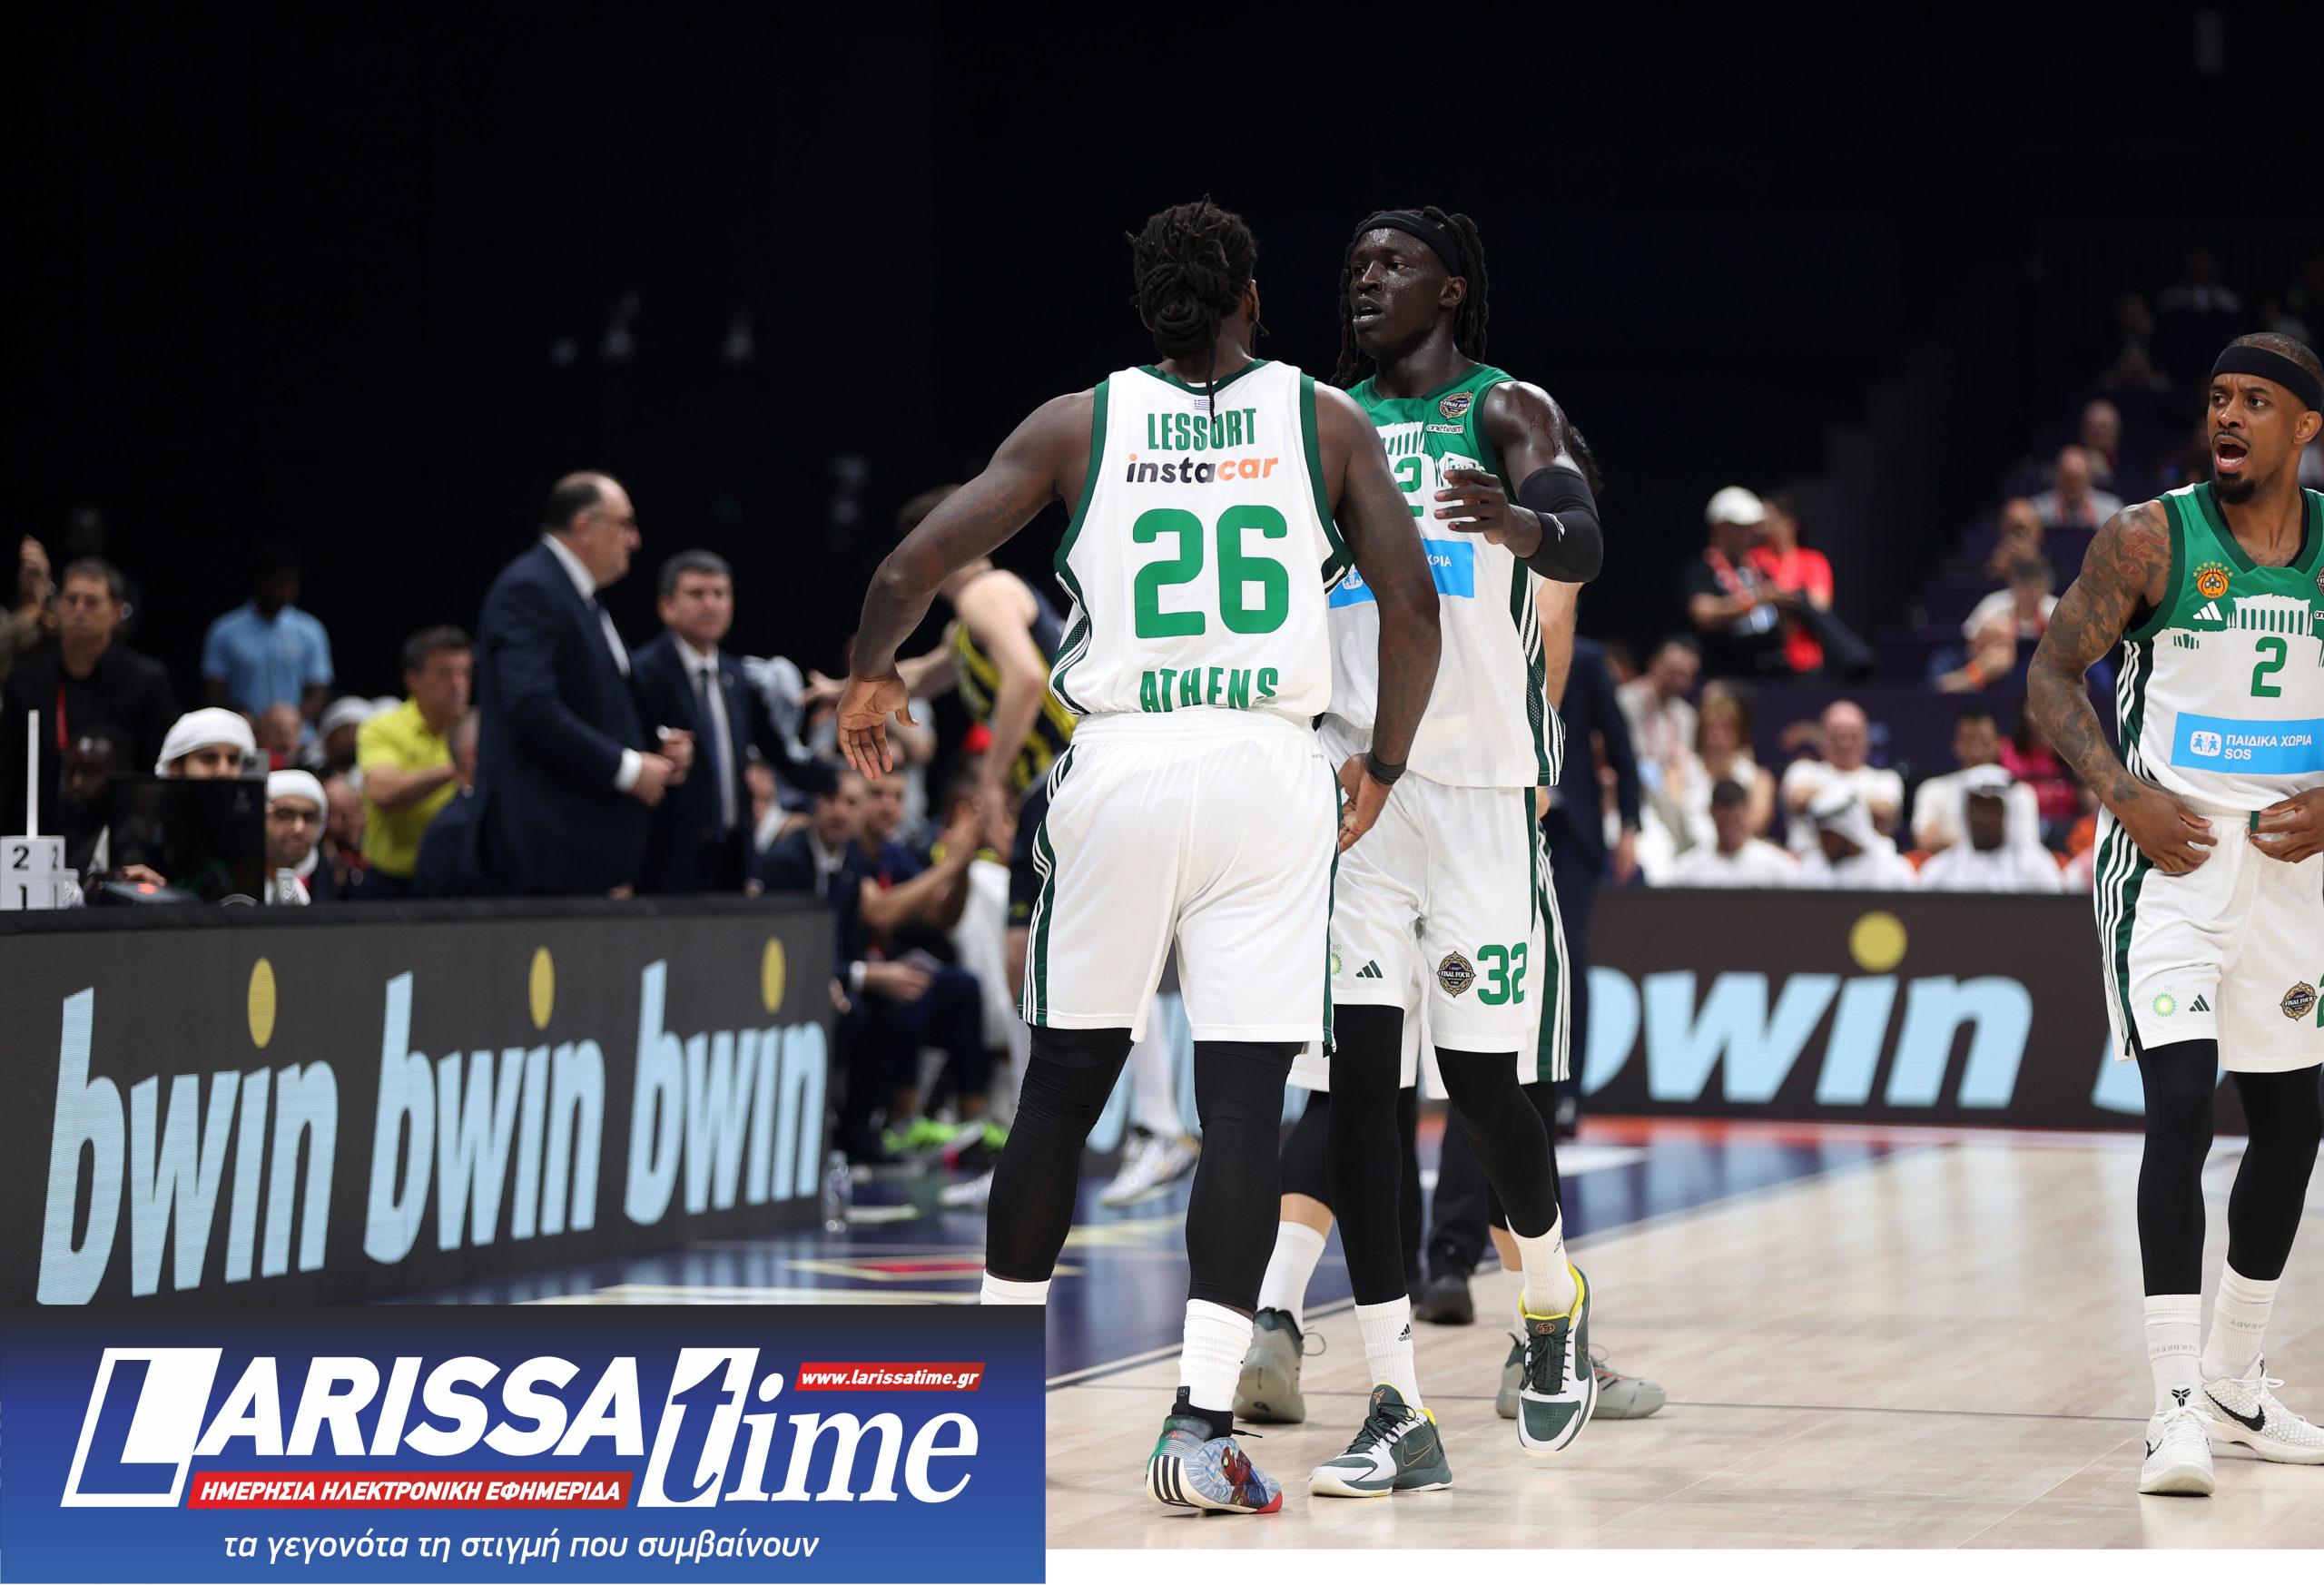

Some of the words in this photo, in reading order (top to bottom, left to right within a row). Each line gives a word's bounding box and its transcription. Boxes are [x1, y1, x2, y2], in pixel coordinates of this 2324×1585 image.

[1147, 408, 1256, 451] LESSORT
[1127, 453, 1279, 484] instacar
[1394, 456, 1423, 517] 2
[1133, 505, 1289, 639] 26
[1139, 667, 1278, 713] ATHENS
[2250, 636, 2288, 697] 2
[2224, 748, 2251, 760] SOS
[2226, 734, 2277, 746] ΠΑΙΔΙΚΑ
[2280, 734, 2312, 747] ΧΩΡΙΑ
[13, 843, 30, 871] 2
[1477, 942, 1527, 1005] 32
[364, 946, 605, 1264] bwin
[625, 937, 828, 1225] bwin
[36, 958, 337, 1304] bwin
